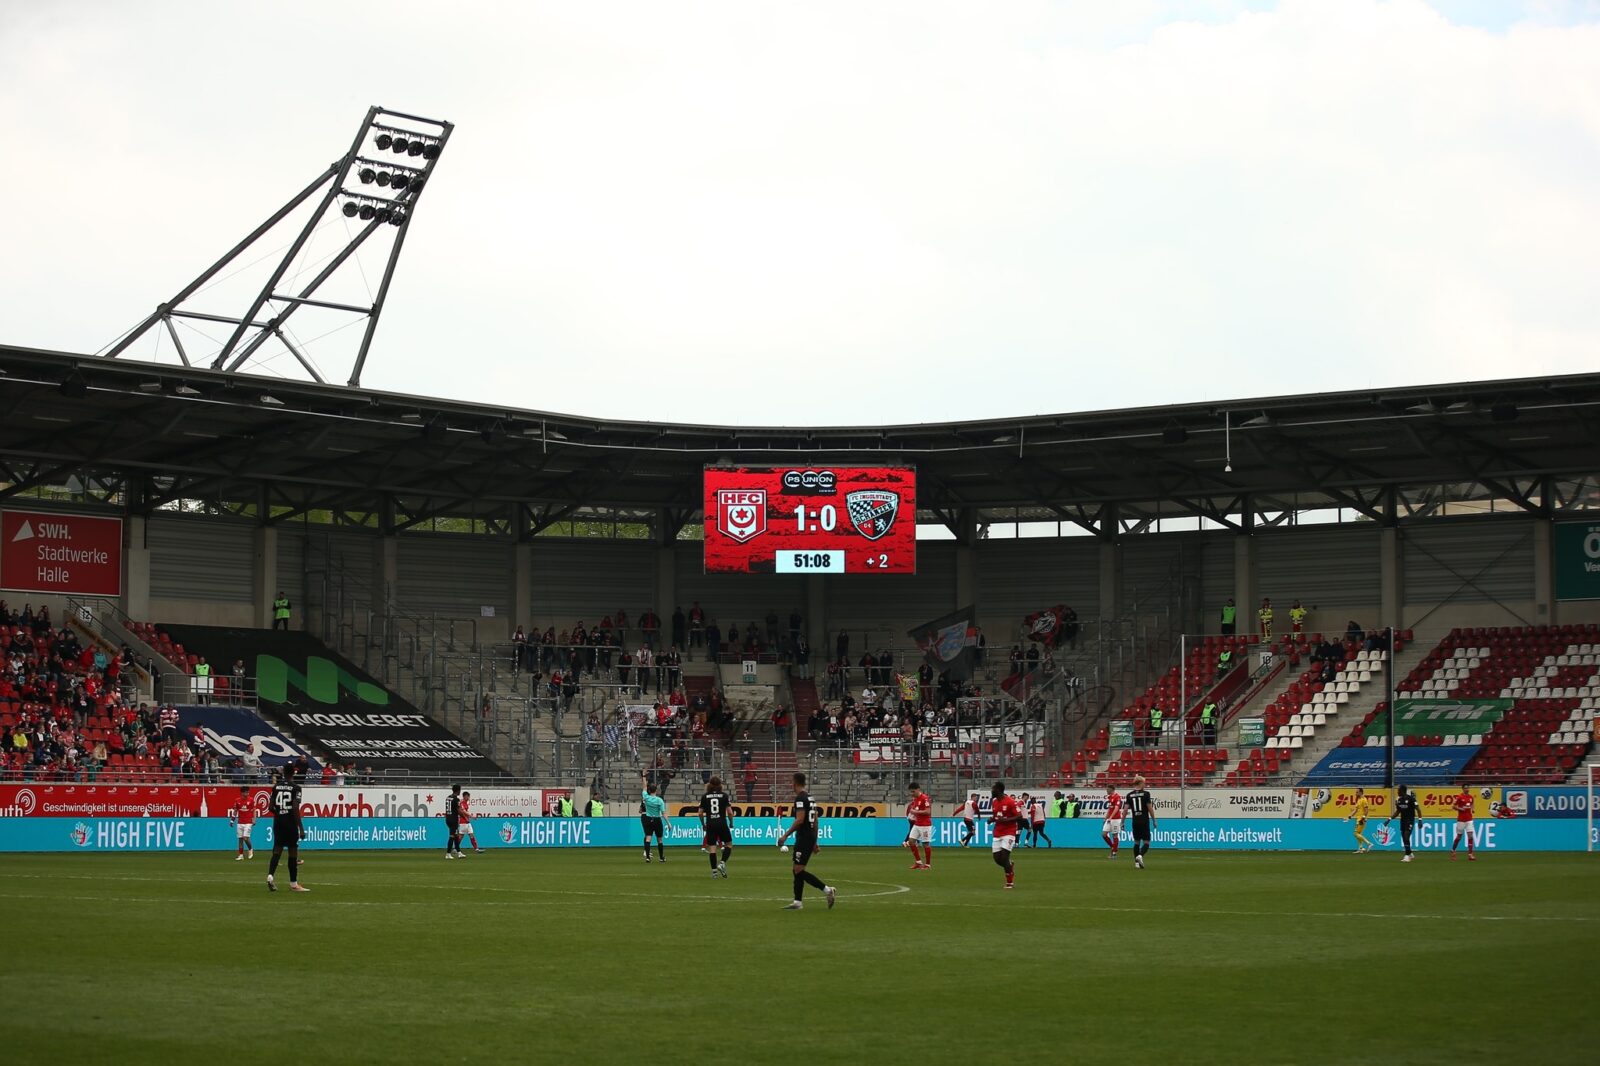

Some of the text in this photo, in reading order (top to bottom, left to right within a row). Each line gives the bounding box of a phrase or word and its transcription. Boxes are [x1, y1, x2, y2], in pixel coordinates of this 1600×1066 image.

[722, 494, 762, 504] HFC
[794, 504, 836, 531] 1:0
[854, 502, 893, 524] SCHANZER
[38, 523, 72, 540] SWH.
[37, 545, 108, 564] Stadtwerke
[794, 554, 831, 567] 51:08
[879, 554, 888, 568] 2
[37, 566, 70, 583] Halle
[1402, 704, 1496, 719] TTM
[288, 713, 431, 727] MOBILEBET
[319, 738, 364, 748] DEINE
[1328, 759, 1453, 770] Geträkehof
[275, 791, 293, 809] 42
[300, 793, 429, 817] ewirbdich
[490, 796, 518, 807] wirklich
[521, 796, 538, 807] tolle
[710, 798, 719, 814] 8
[1132, 796, 1143, 812] 11
[1150, 797, 1182, 810] Köstritze
[1230, 796, 1284, 804] ZUSAMMEN
[1535, 796, 1587, 810] RADIO
[42, 802, 174, 814] Geschwindigkeit ist unsere Stärke!
[97, 821, 185, 848] HIGH FIVE
[265, 827, 273, 841] 3
[372, 826, 427, 841] Arbeitswelt
[521, 820, 591, 844] HIGH FIVE
[664, 826, 670, 839] 3
[765, 825, 833, 839] Arbelt
[1218, 827, 1282, 843] Arbeitswelt
[1591, 828, 1598, 843] 3
